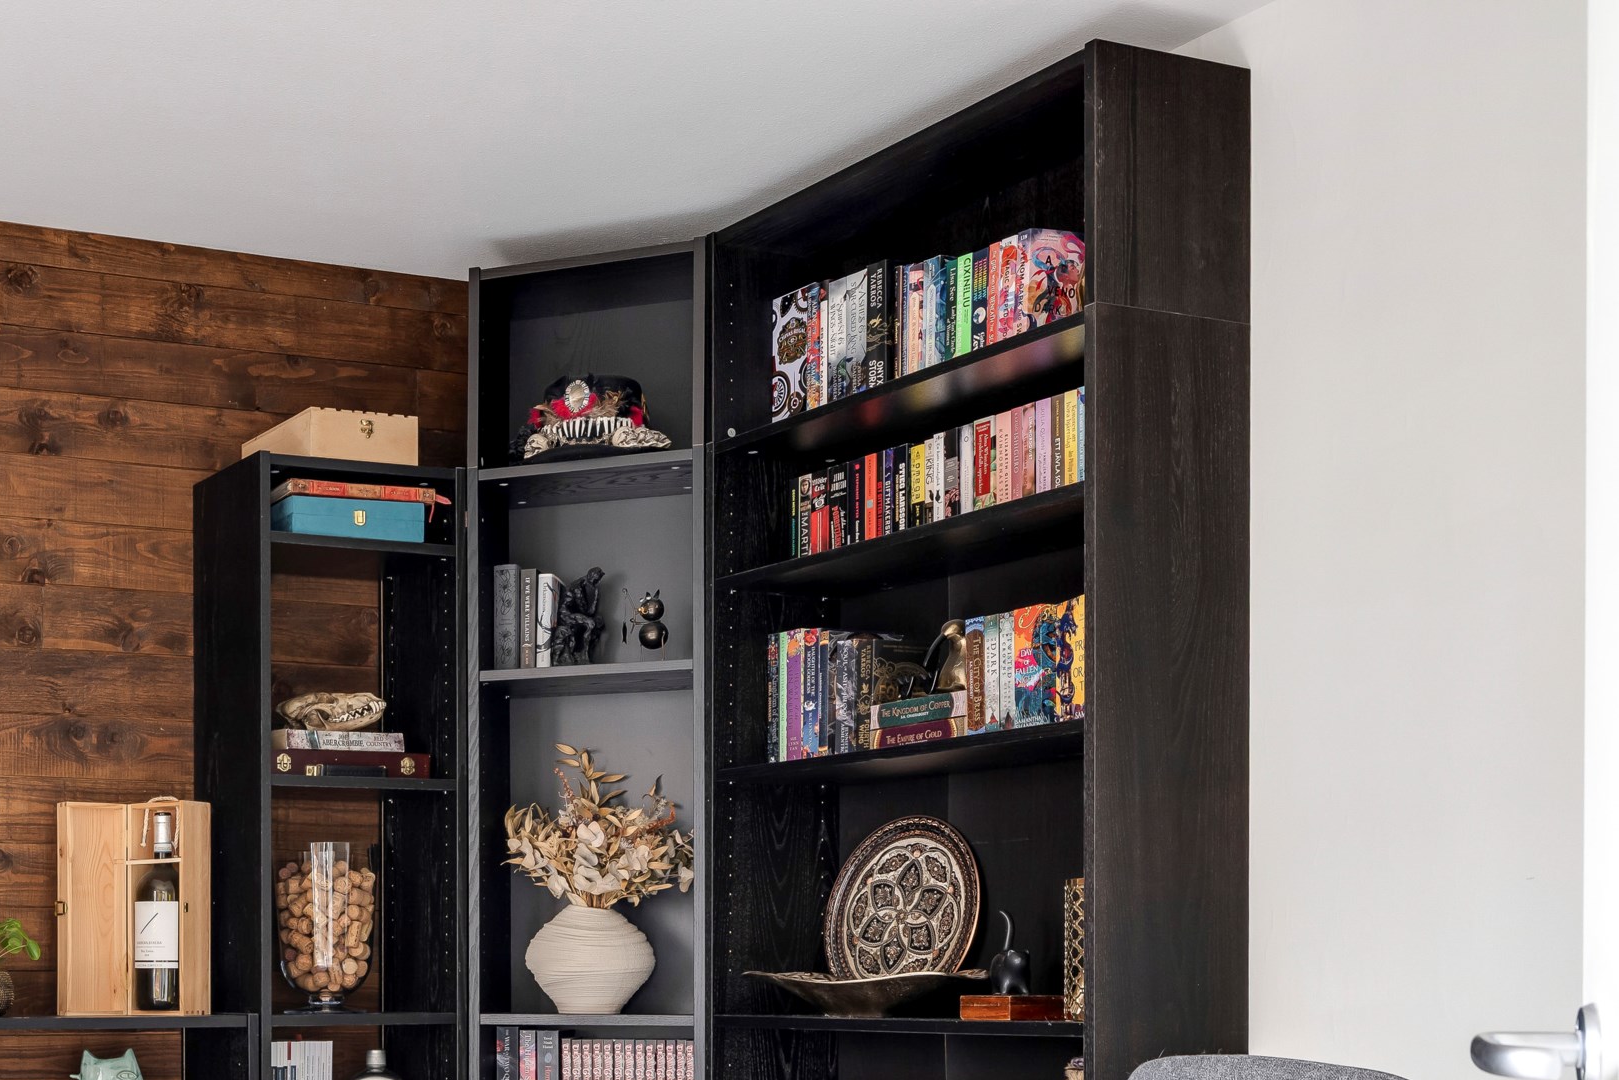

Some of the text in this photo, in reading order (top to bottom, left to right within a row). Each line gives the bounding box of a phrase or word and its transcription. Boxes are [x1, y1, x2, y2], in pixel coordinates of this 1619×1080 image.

[876, 361, 884, 385] ONYX
[525, 585, 530, 594] WE
[974, 683, 980, 693] OF
